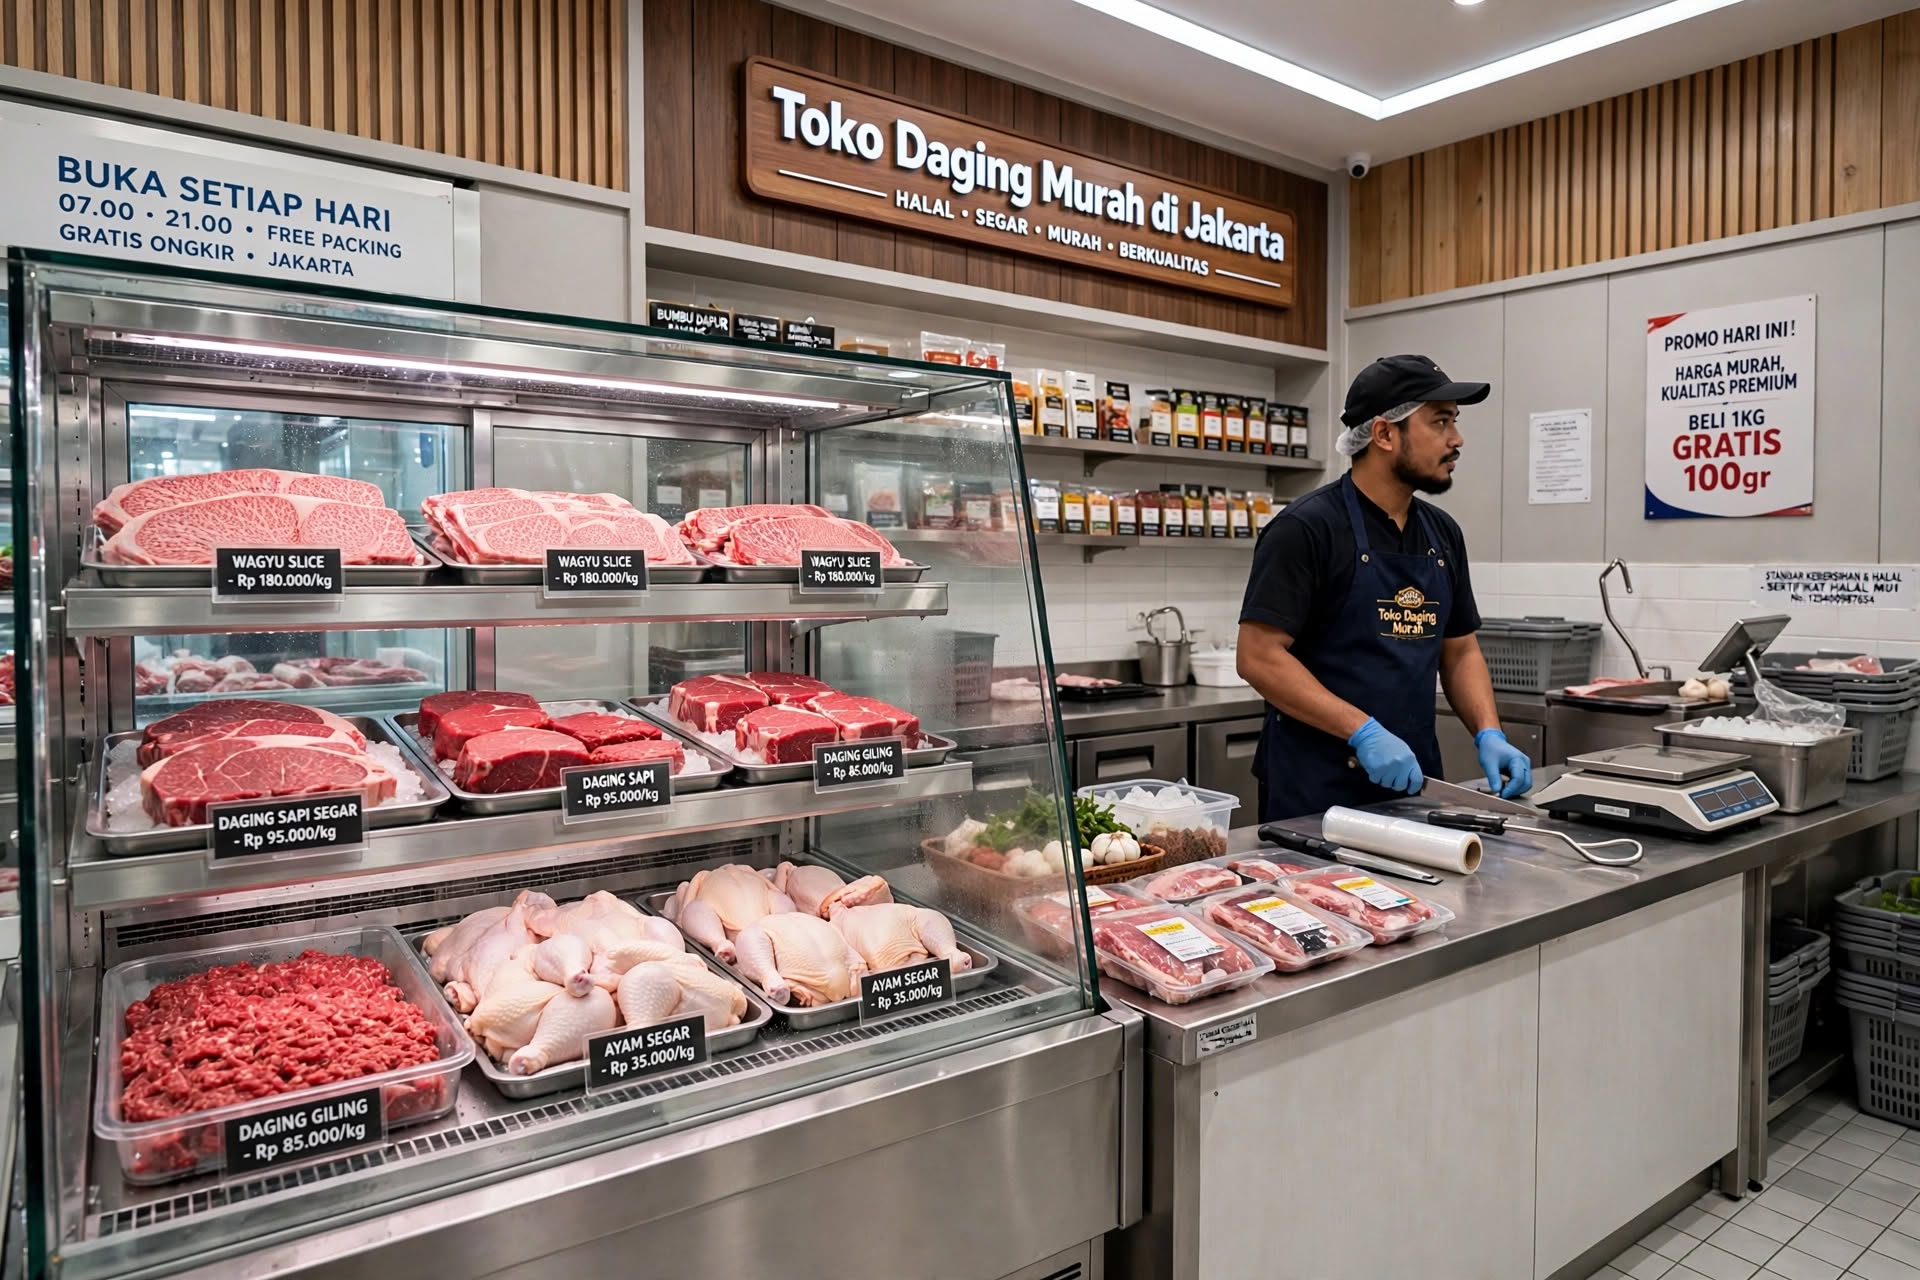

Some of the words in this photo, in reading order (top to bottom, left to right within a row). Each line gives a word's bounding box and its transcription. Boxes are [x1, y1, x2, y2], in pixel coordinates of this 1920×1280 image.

[770, 85, 884, 160] Toko
[895, 119, 1032, 207] Daging
[1042, 159, 1144, 226] Murah
[1151, 193, 1178, 235] di
[1184, 201, 1285, 261] Jakarta
[58, 155, 166, 198] BUKA
[179, 176, 303, 216] SETIAP
[315, 199, 391, 232] HARI
[59, 193, 134, 221] 07.00
[165, 209, 232, 234] 21.00
[267, 225, 315, 246] FREE
[321, 232, 402, 259] PACKING
[896, 191, 954, 220] HALAL
[975, 209, 1028, 235] SEGAR
[1047, 226, 1101, 252] MURAH
[1119, 241, 1209, 276] BERKUALITAS
[59, 223, 143, 249] GRATIS
[150, 235, 234, 262] ONGKIR
[268, 252, 354, 277] JAKARTA
[657, 308, 694, 324] BUMBU
[1664, 331, 1718, 352] PROMO
[1723, 325, 1760, 345] HARI
[1765, 320, 1796, 341] INI!
[1675, 362, 1723, 381] HARGA
[1727, 355, 1785, 375] MURAH,
[1661, 380, 1725, 401] KUALITAS
[1729, 373, 1797, 395] PREMIUM
[1689, 411, 1725, 431] BELI
[1731, 409, 1765, 428] 1KG
[1672, 428, 1782, 460] GRATIS
[1683, 461, 1771, 494] 100gr
[232, 555, 285, 569] WAGYU
[288, 555, 325, 569] SLICE
[558, 556, 600, 568] WAGYU
[603, 556, 632, 568] SLICE
[810, 556, 845, 568] WAGYU
[848, 556, 871, 568] SLICE
[238, 574, 256, 589] Rp
[259, 574, 332, 590] 180.000/kg
[563, 572, 578, 586] Rp
[580, 572, 638, 586] 180.000/kg
[814, 571, 826, 584] Rp
[1830, 582, 1869, 593] HALAL
[1873, 583, 1898, 592] MUI
[1872, 572, 1902, 582] HALAL
[1378, 608, 1402, 620] Toko
[1404, 609, 1436, 625] Daging
[824, 750, 860, 764] DAGING
[862, 746, 893, 760] GILING
[582, 773, 626, 790] DAGING
[629, 770, 654, 785] SAPI
[833, 767, 846, 780] Rp
[586, 794, 600, 808] Rp
[603, 789, 659, 805] 95.000/kg
[218, 811, 275, 831] DAGING
[278, 808, 310, 824] SAPI
[313, 803, 358, 821] SEGAR
[244, 833, 263, 850] Rp
[267, 825, 337, 845] 95.000/kg
[871, 975, 902, 993] AYAM
[904, 967, 939, 984] SEGAR
[878, 997, 892, 1011] Rp
[894, 984, 943, 1005] 35.000/kg
[604, 1037, 643, 1058] AYAM
[647, 1026, 690, 1047] SEGAR
[610, 1060, 628, 1076] Rp
[631, 1045, 695, 1071] 35.000/kg
[239, 1112, 307, 1142] DAGING
[311, 1099, 368, 1125] GILING
[255, 1144, 278, 1161] Rp
[283, 1123, 366, 1153] 85.000/kg
